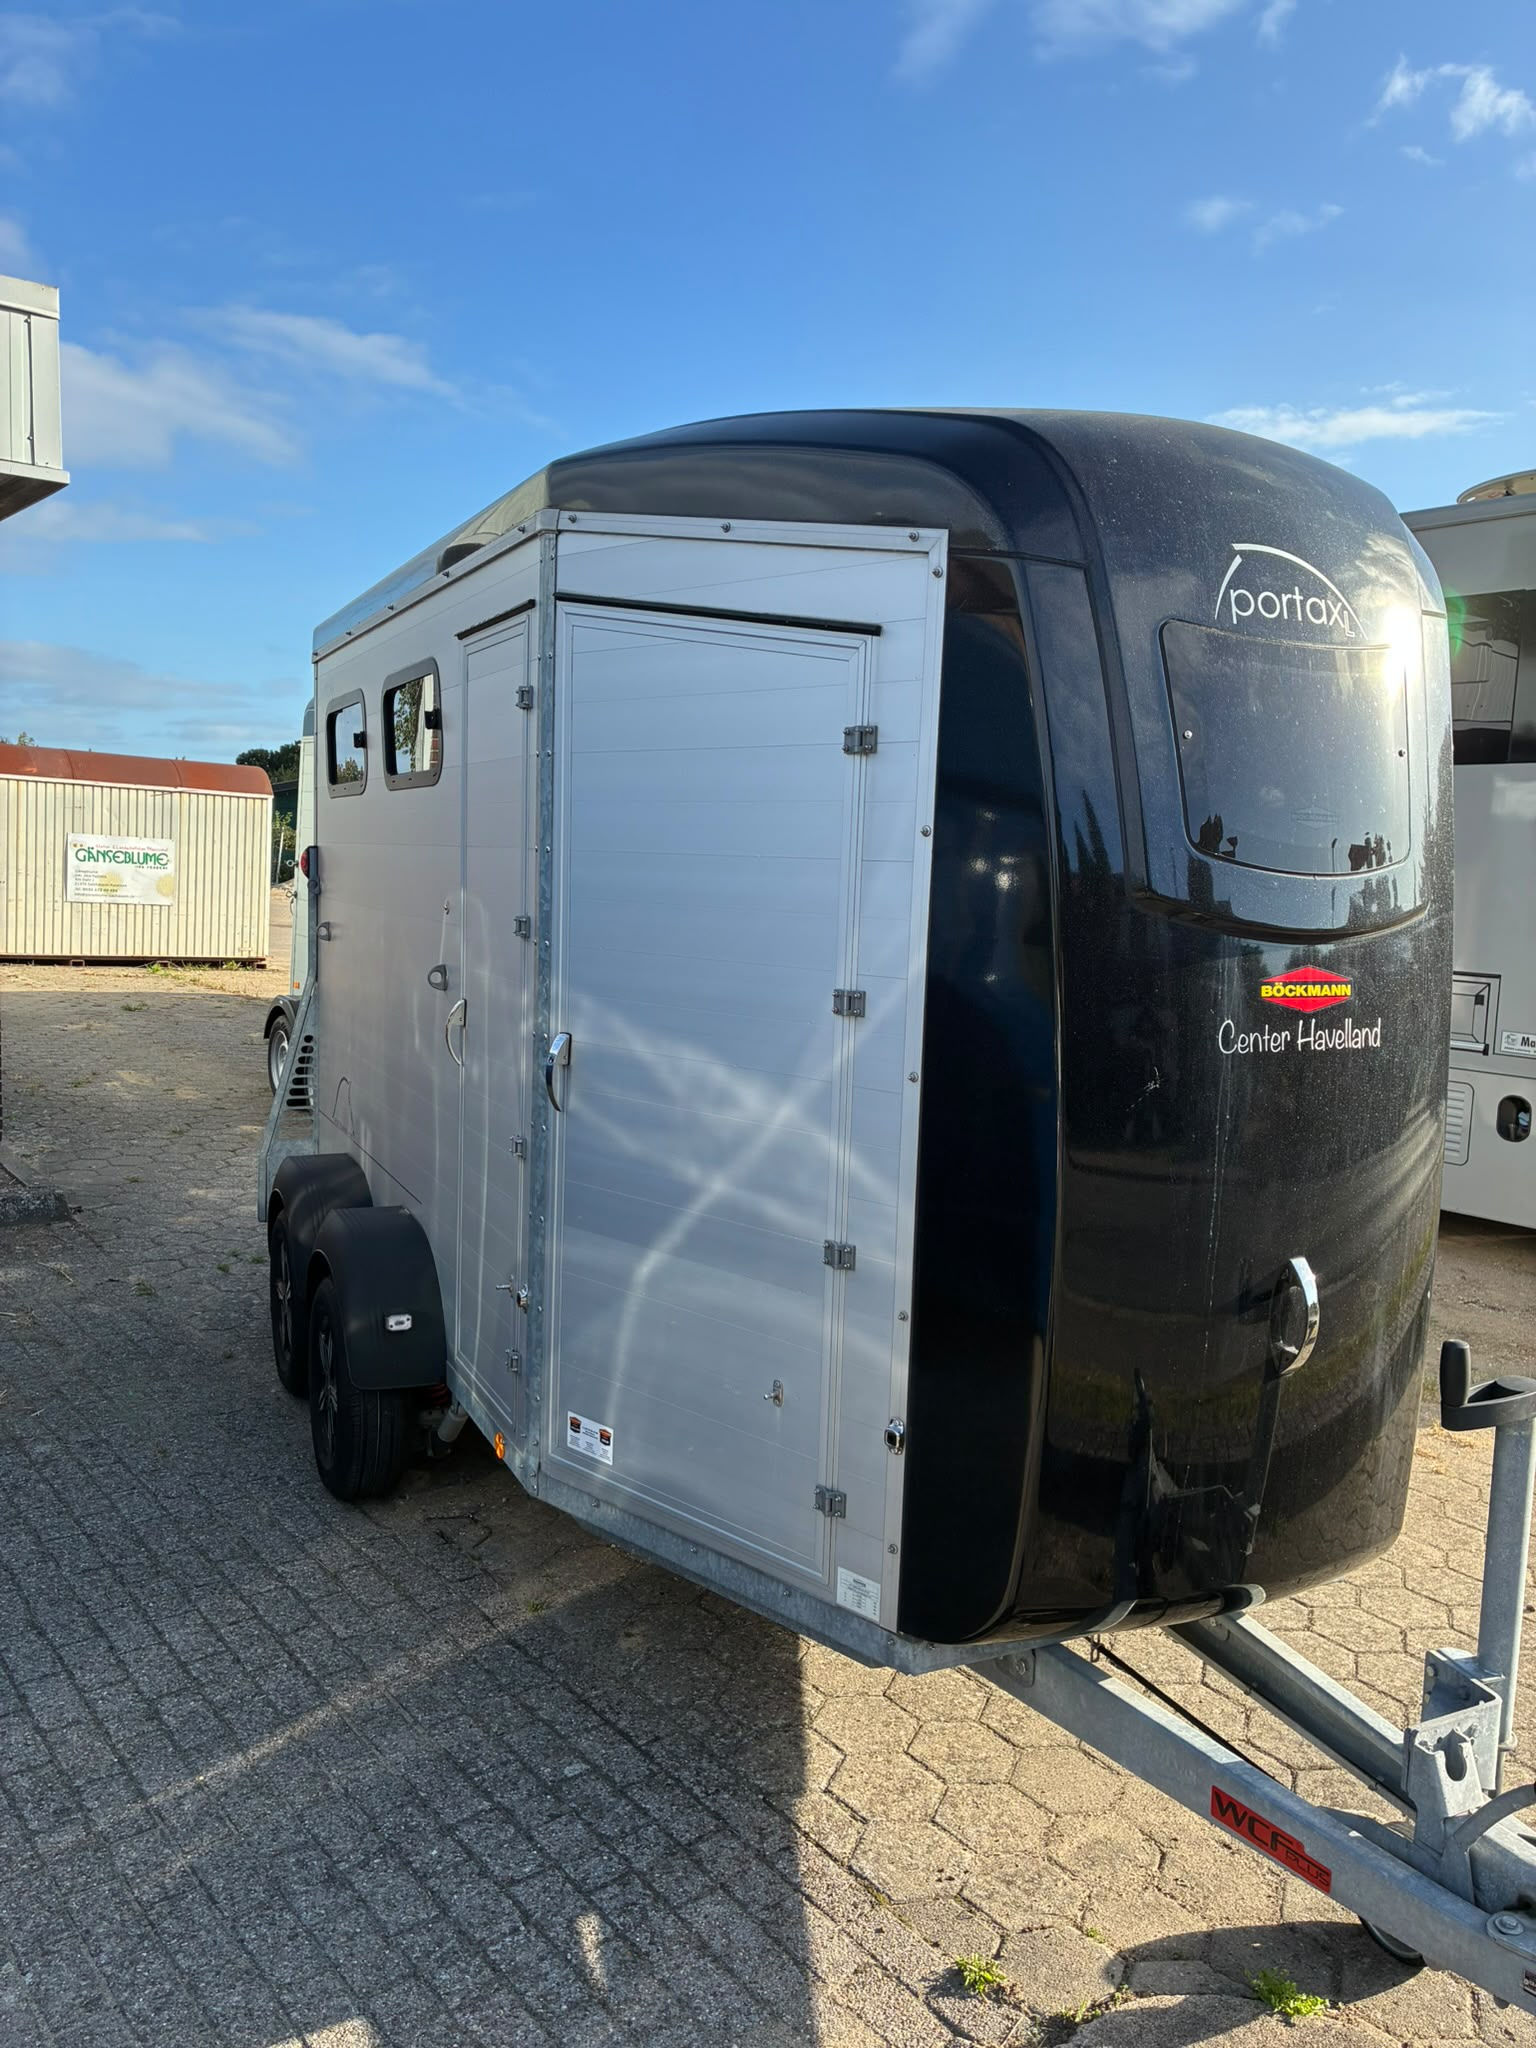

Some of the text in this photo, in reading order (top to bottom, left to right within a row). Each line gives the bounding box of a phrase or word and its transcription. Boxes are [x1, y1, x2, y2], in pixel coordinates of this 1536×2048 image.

[1230, 586, 1344, 627] portax
[75, 846, 169, 866] GÄNSEBLUME
[1260, 982, 1351, 998] BÖCKMANN
[1218, 1018, 1382, 1054] Center Havelland
[1214, 1790, 1295, 1852] WCF
